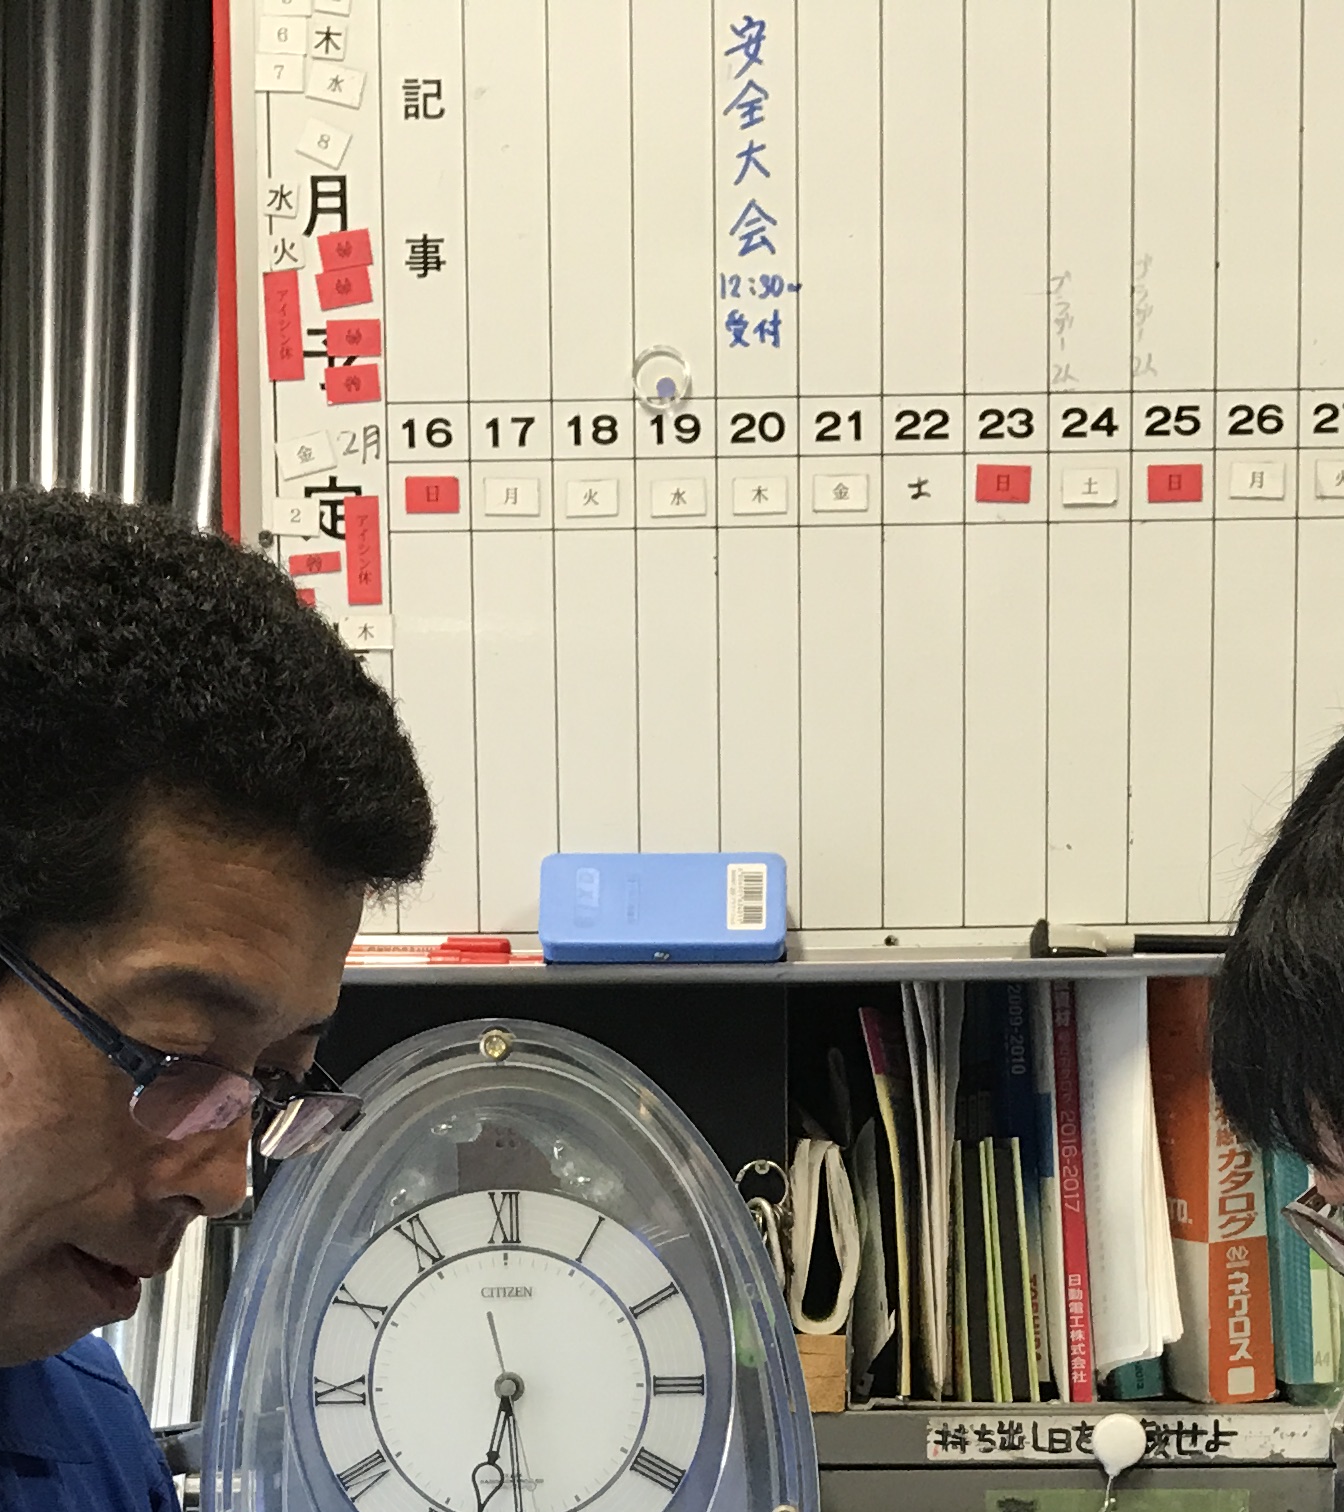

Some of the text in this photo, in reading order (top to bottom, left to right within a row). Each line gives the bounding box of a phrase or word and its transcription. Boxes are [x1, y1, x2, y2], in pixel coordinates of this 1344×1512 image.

[277, 27, 287, 42] 6
[314, 26, 342, 54] 木
[273, 65, 284, 80] 7
[327, 76, 344, 93] 水
[317, 133, 331, 150] 8
[723, 15, 778, 257] 安全大会
[266, 184, 293, 211] 水
[273, 239, 298, 264] 火
[725, 309, 781, 347] 受付
[402, 418, 453, 448] 16
[486, 417, 535, 447] 17
[568, 415, 618, 445] 18
[651, 414, 700, 444] 19
[731, 412, 785, 443] 20
[816, 411, 862, 442] 21
[895, 409, 949, 439] 22
[979, 408, 1034, 438] 23
[1062, 407, 1118, 438] 24
[1145, 406, 1201, 436] 25
[1228, 404, 1284, 435] 26
[296, 445, 316, 464] 金
[426, 485, 439, 502] 日
[505, 487, 517, 504] 月
[584, 490, 599, 505] 火
[671, 489, 687, 504] 水
[752, 486, 768, 501] 木
[833, 483, 850, 500] 金
[997, 475, 1010, 491] 日
[1082, 477, 1099, 495] 土
[1168, 474, 1182, 491] 日
[1250, 471, 1265, 489] 月
[290, 508, 301, 523] 2
[1006, 984, 1027, 1075] 2009-2010
[1060, 1110, 1082, 1214] 2016-2017
[480, 1286, 533, 1299] CITIZEN
[1068, 1273, 1088, 1384] 日動電工株式会社
[1314, 1354, 1331, 1368] A4
[934, 1418, 1239, 1458] 持ち出し日をせよ
